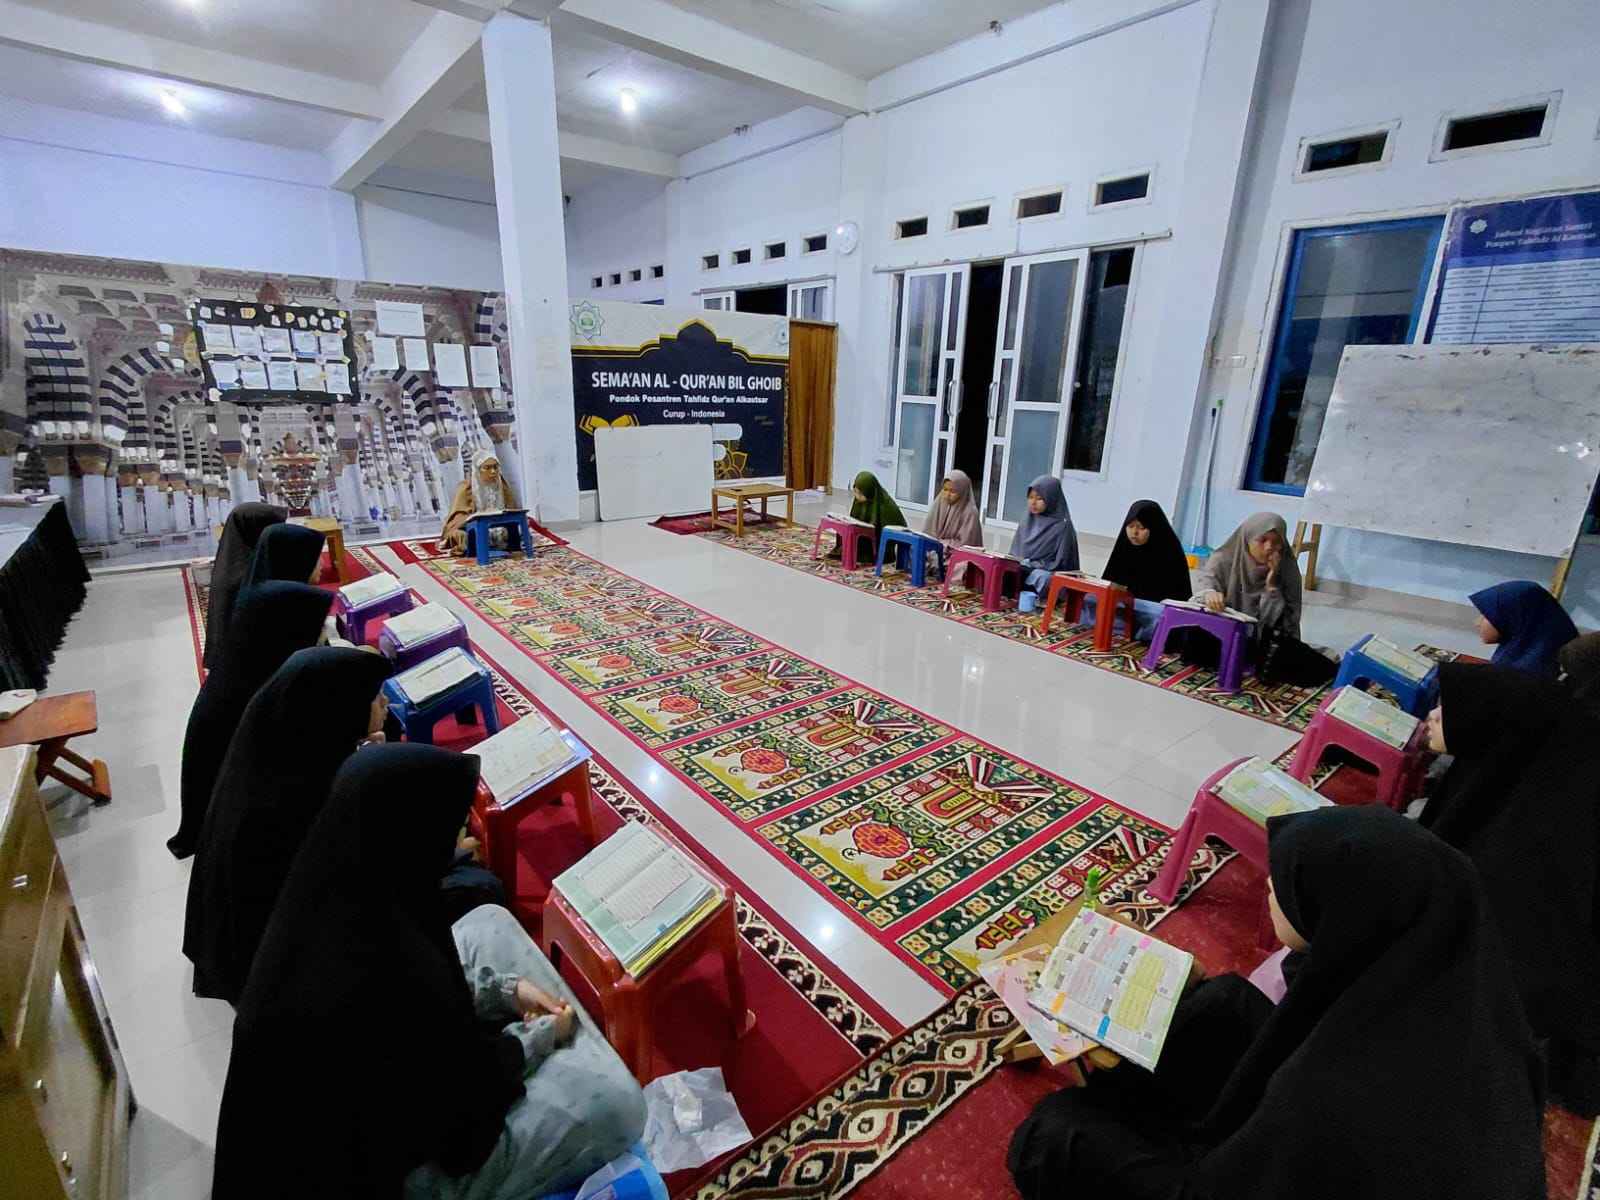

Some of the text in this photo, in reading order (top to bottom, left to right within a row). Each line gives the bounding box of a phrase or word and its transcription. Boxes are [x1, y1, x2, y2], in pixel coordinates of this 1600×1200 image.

[653, 373, 671, 388] AL
[727, 375, 745, 390] BIL
[747, 376, 782, 391] GHOIB
[609, 394, 641, 403] Pondok
[642, 394, 682, 403] Pesantren
[683, 395, 710, 403] Tahfidz
[736, 396, 768, 404] Alkautsar
[663, 410, 686, 419] Curup
[691, 410, 726, 418] Indonesia
